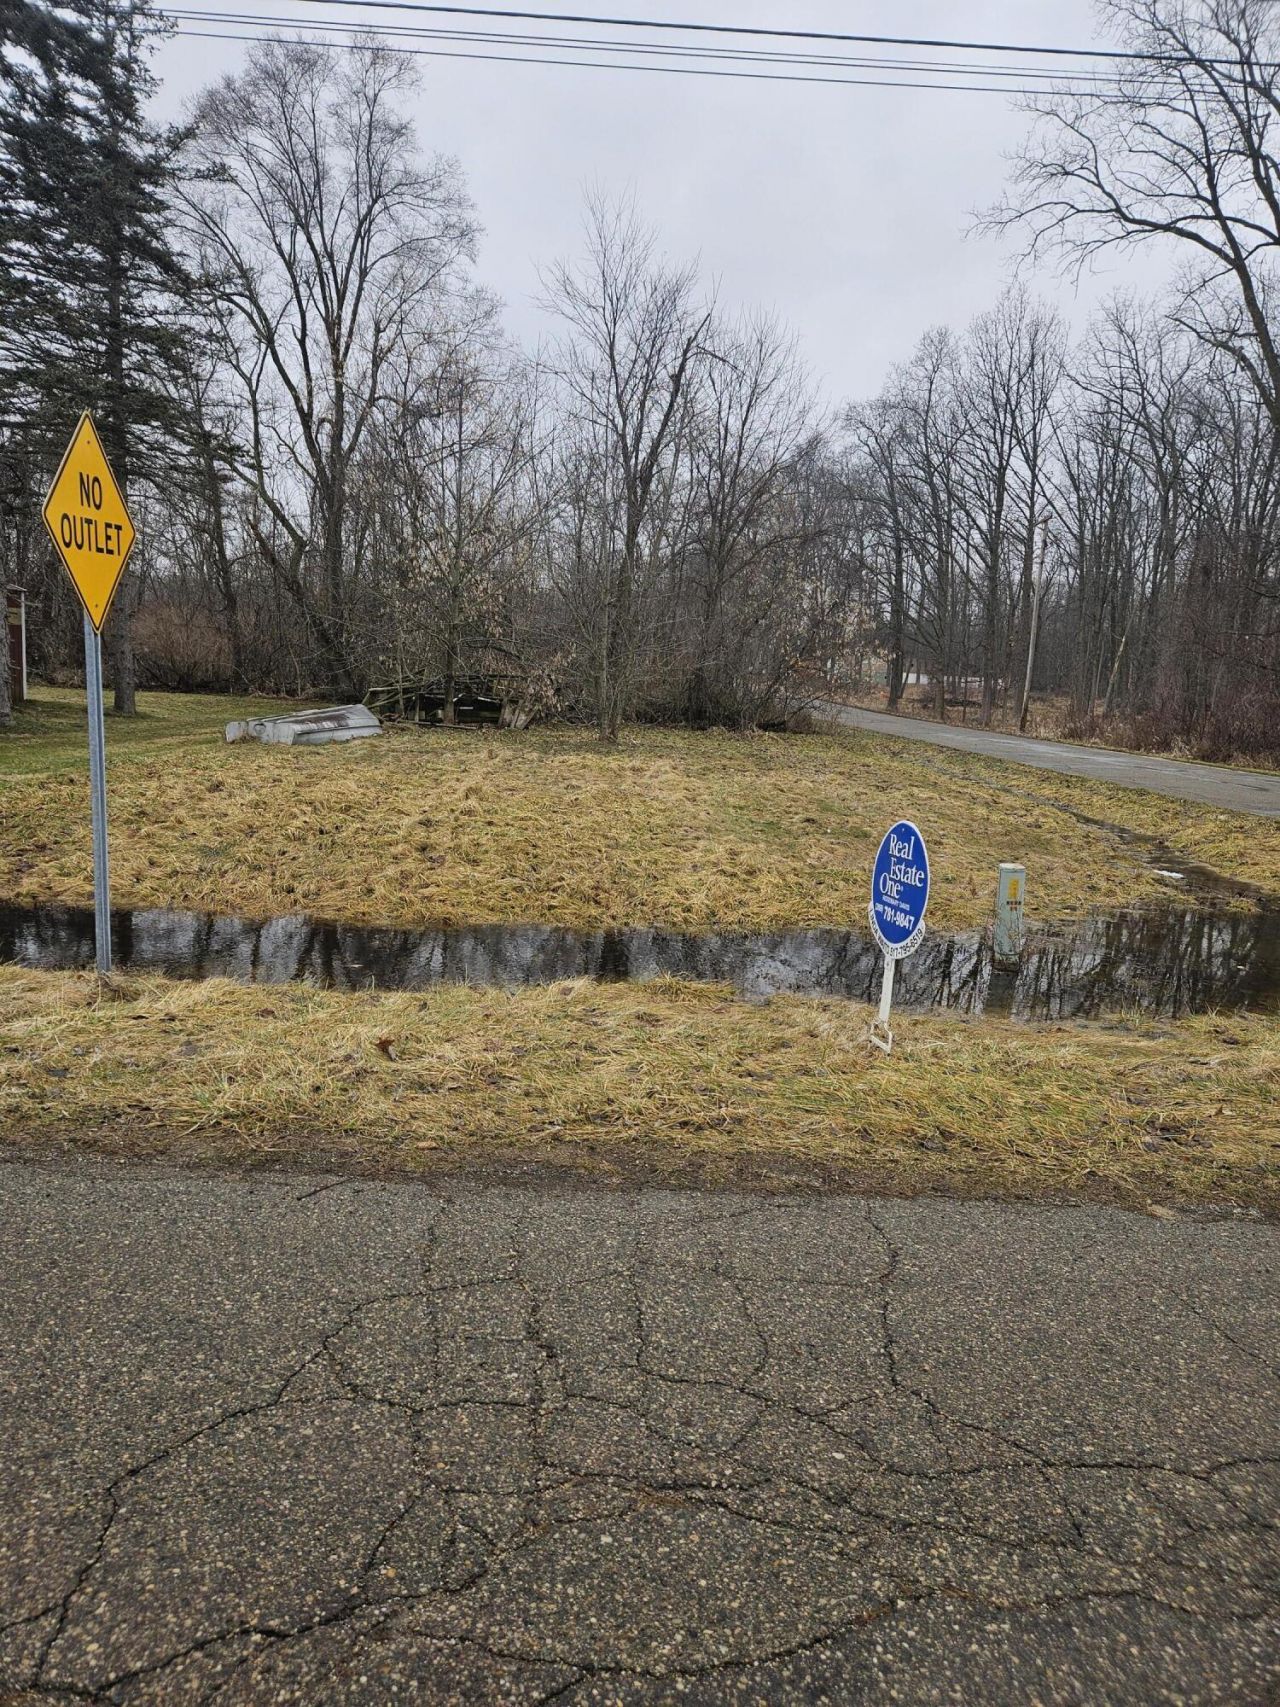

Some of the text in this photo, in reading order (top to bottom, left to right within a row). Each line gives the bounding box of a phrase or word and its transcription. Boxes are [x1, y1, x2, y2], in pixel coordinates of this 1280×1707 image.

[79, 472, 102, 510] NO
[60, 512, 123, 556] OUTLET
[889, 833, 915, 860] Real
[880, 872, 901, 899] One
[890, 857, 925, 887] Estate
[883, 905, 915, 930] 781-9847
